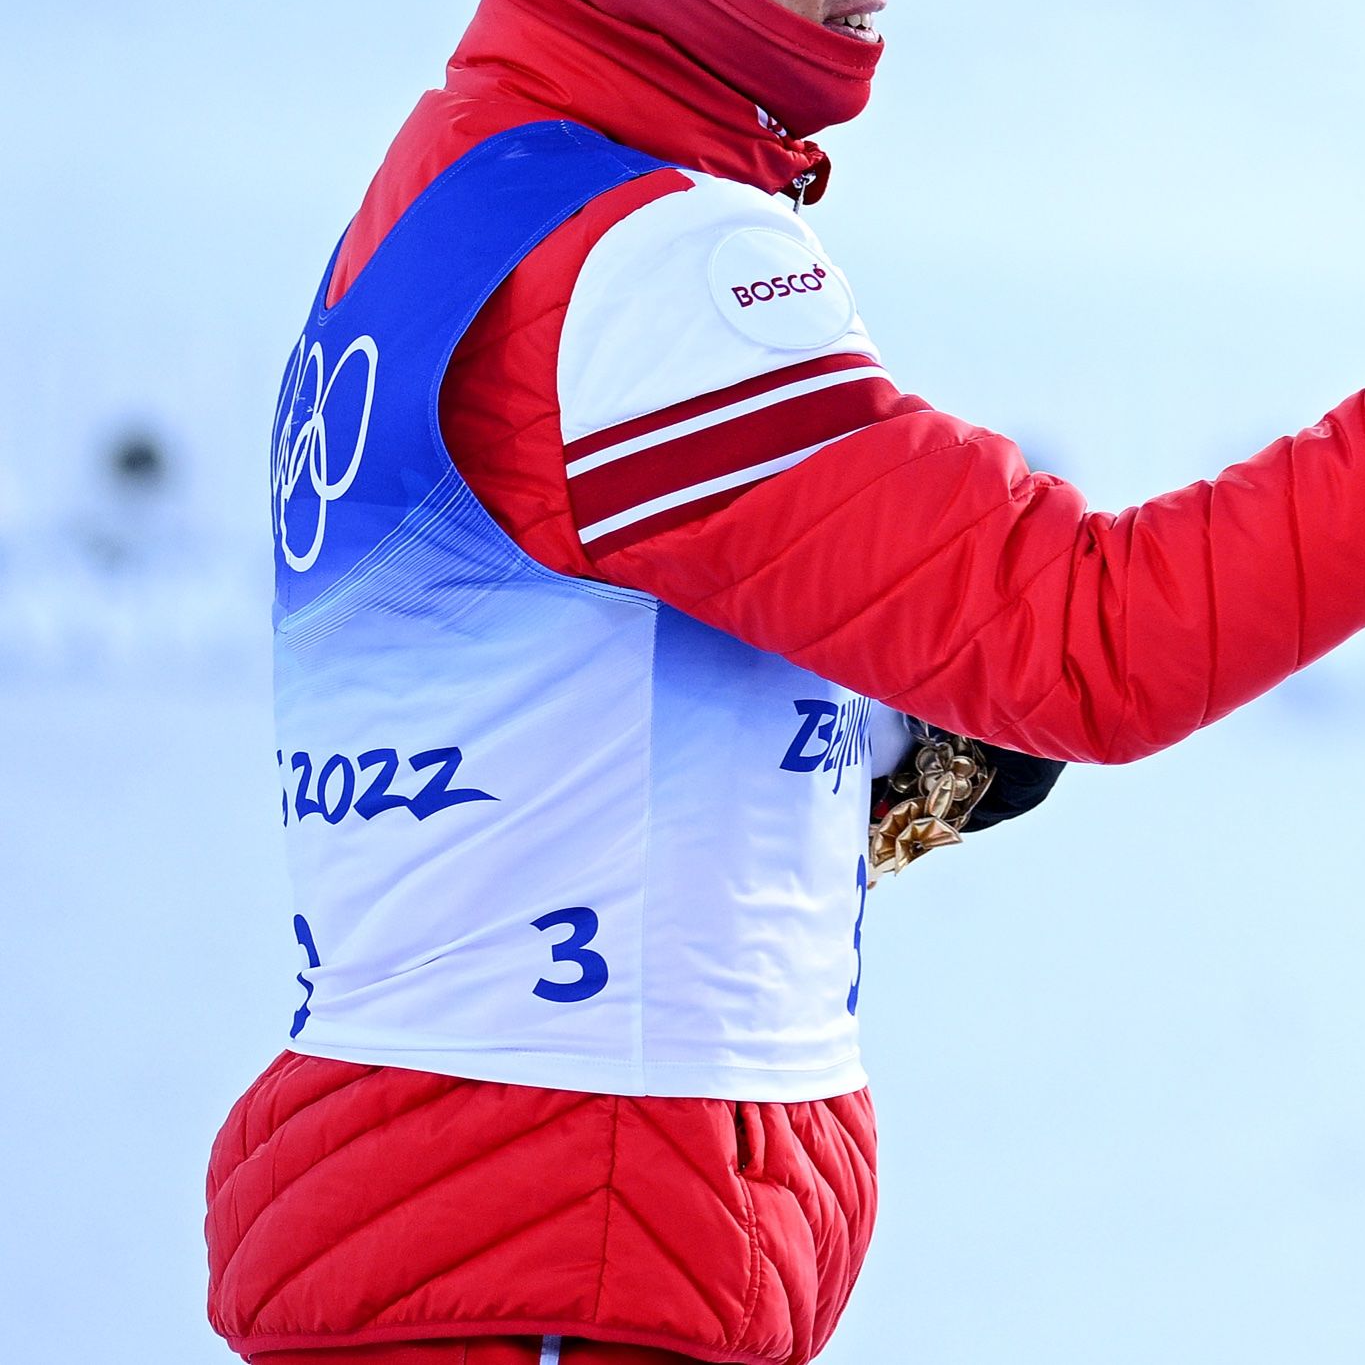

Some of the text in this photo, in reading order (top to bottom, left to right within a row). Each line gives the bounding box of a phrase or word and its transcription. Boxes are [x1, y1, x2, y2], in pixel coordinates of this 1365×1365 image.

[731, 273, 823, 308] BOSCO
[291, 746, 502, 826] 2022
[779, 697, 873, 796] BEIJIN
[529, 906, 609, 1003] 3
